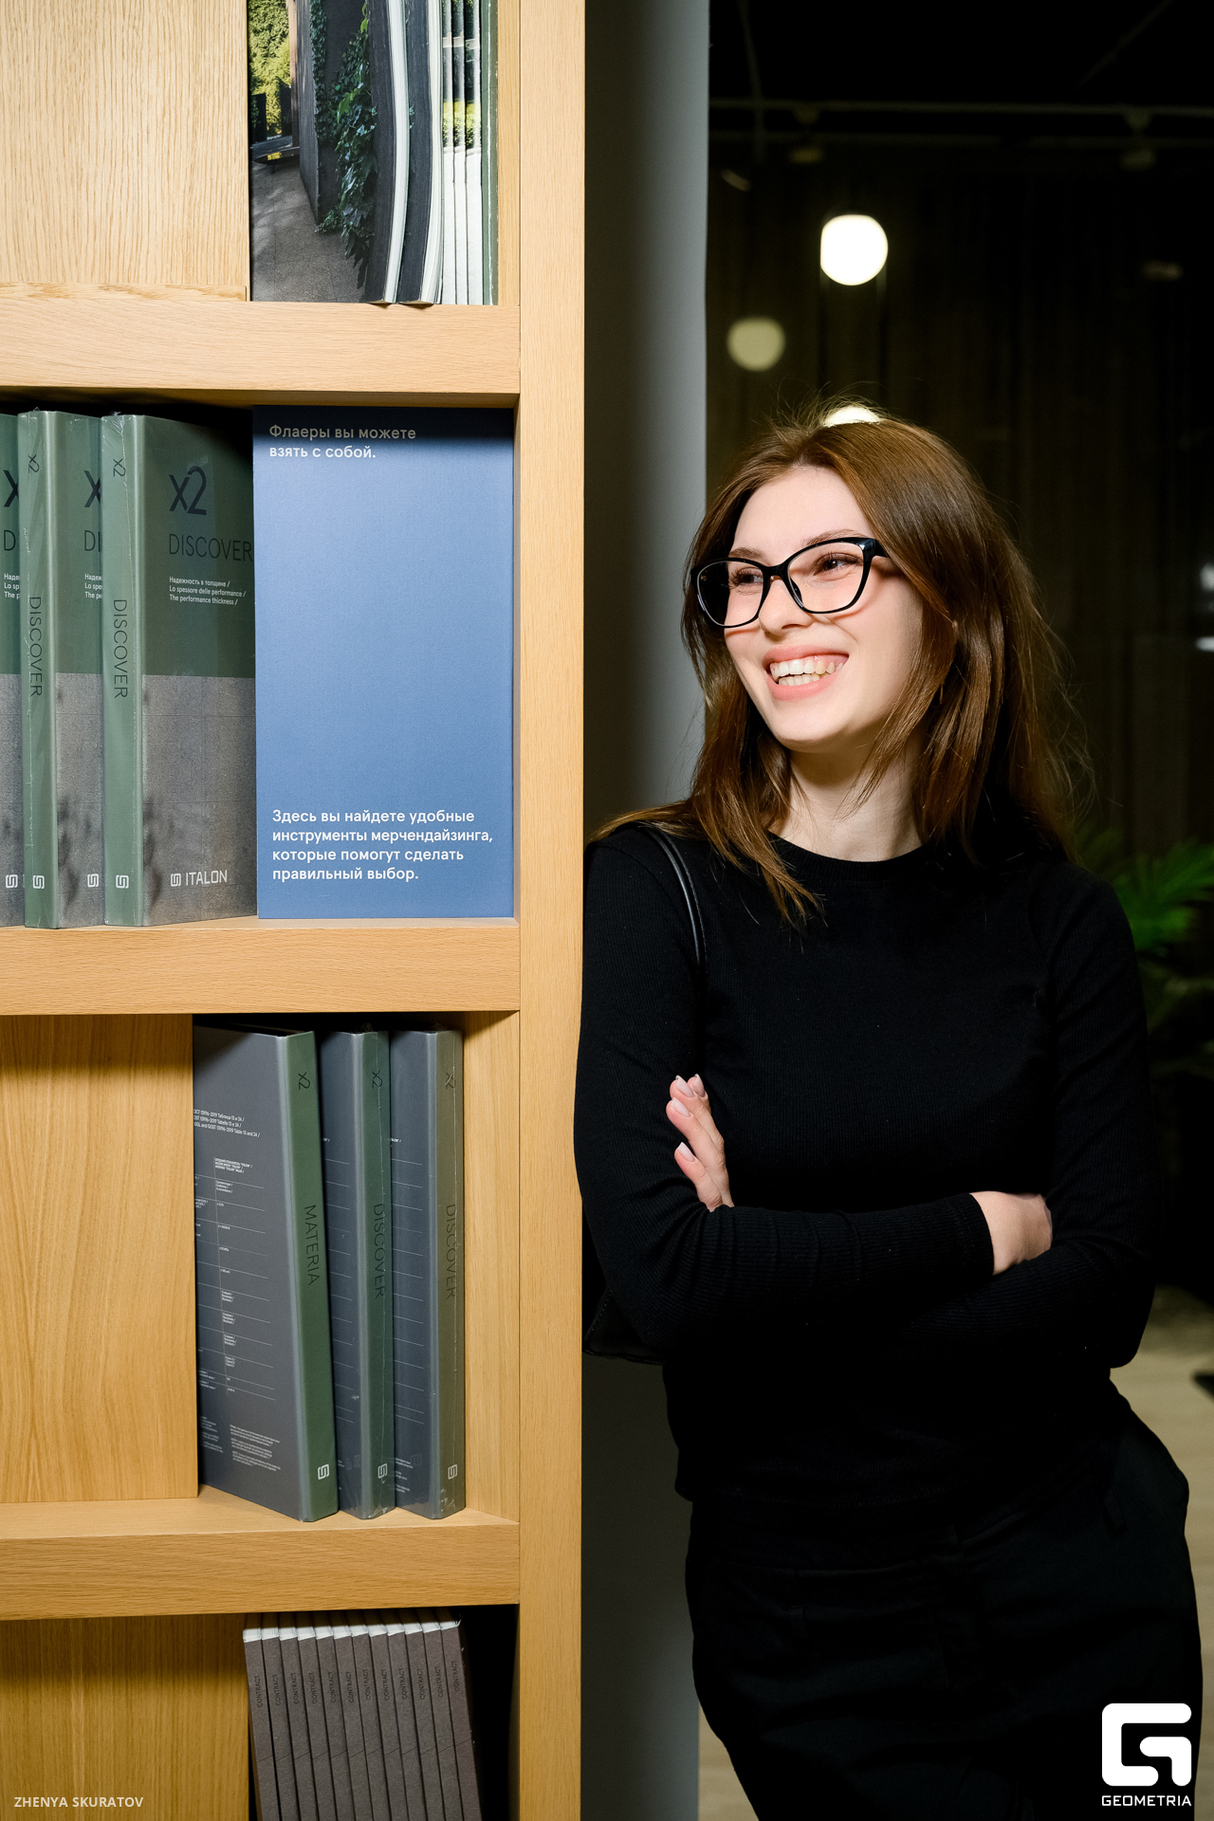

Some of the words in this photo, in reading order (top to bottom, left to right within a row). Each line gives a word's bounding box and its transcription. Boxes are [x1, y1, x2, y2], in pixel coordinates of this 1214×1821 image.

[269, 425, 330, 441] Флаеры
[335, 428, 354, 439] вы
[358, 428, 416, 439] можете
[269, 447, 308, 457] взять
[312, 447, 321, 458] с
[325, 445, 376, 458] собой.
[169, 533, 253, 562] DISCOVER
[169, 593, 179, 601] The
[29, 597, 42, 697] DISCOVER
[113, 599, 128, 699] DISCOVER
[272, 809, 317, 824] Здесь
[321, 811, 340, 822] вы
[344, 809, 405, 824] найдете
[409, 809, 475, 824] удобные
[272, 831, 367, 844] инструменты
[371, 828, 493, 844] мерчендайзинга,
[272, 850, 336, 863] которые
[341, 850, 400, 863] помогут
[404, 850, 464, 862] сделать
[185, 870, 228, 886] ITALON
[272, 867, 363, 882] правильный
[367, 867, 419, 882] выбор.
[304, 1204, 321, 1286] MATERIA
[373, 1203, 385, 1299] DISCOVER
[446, 1203, 457, 1300] DISCOVER
[254, 1675, 263, 1708] CONTRACT
[272, 1674, 281, 1706] CONTRACT
[290, 1672, 299, 1704] CONTRACT
[309, 1672, 318, 1704] CONTRACT
[328, 1671, 336, 1703] CONTRACT
[345, 1671, 354, 1703] CONTRACT
[362, 1669, 371, 1700] CONTRACT
[381, 1668, 390, 1700] CONTRACT
[399, 1667, 408, 1699] CONTRACT
[417, 1668, 426, 1699] CONTRACT
[435, 1666, 444, 1697] CONTRACT
[451, 1660, 460, 1692] CONTRACT
